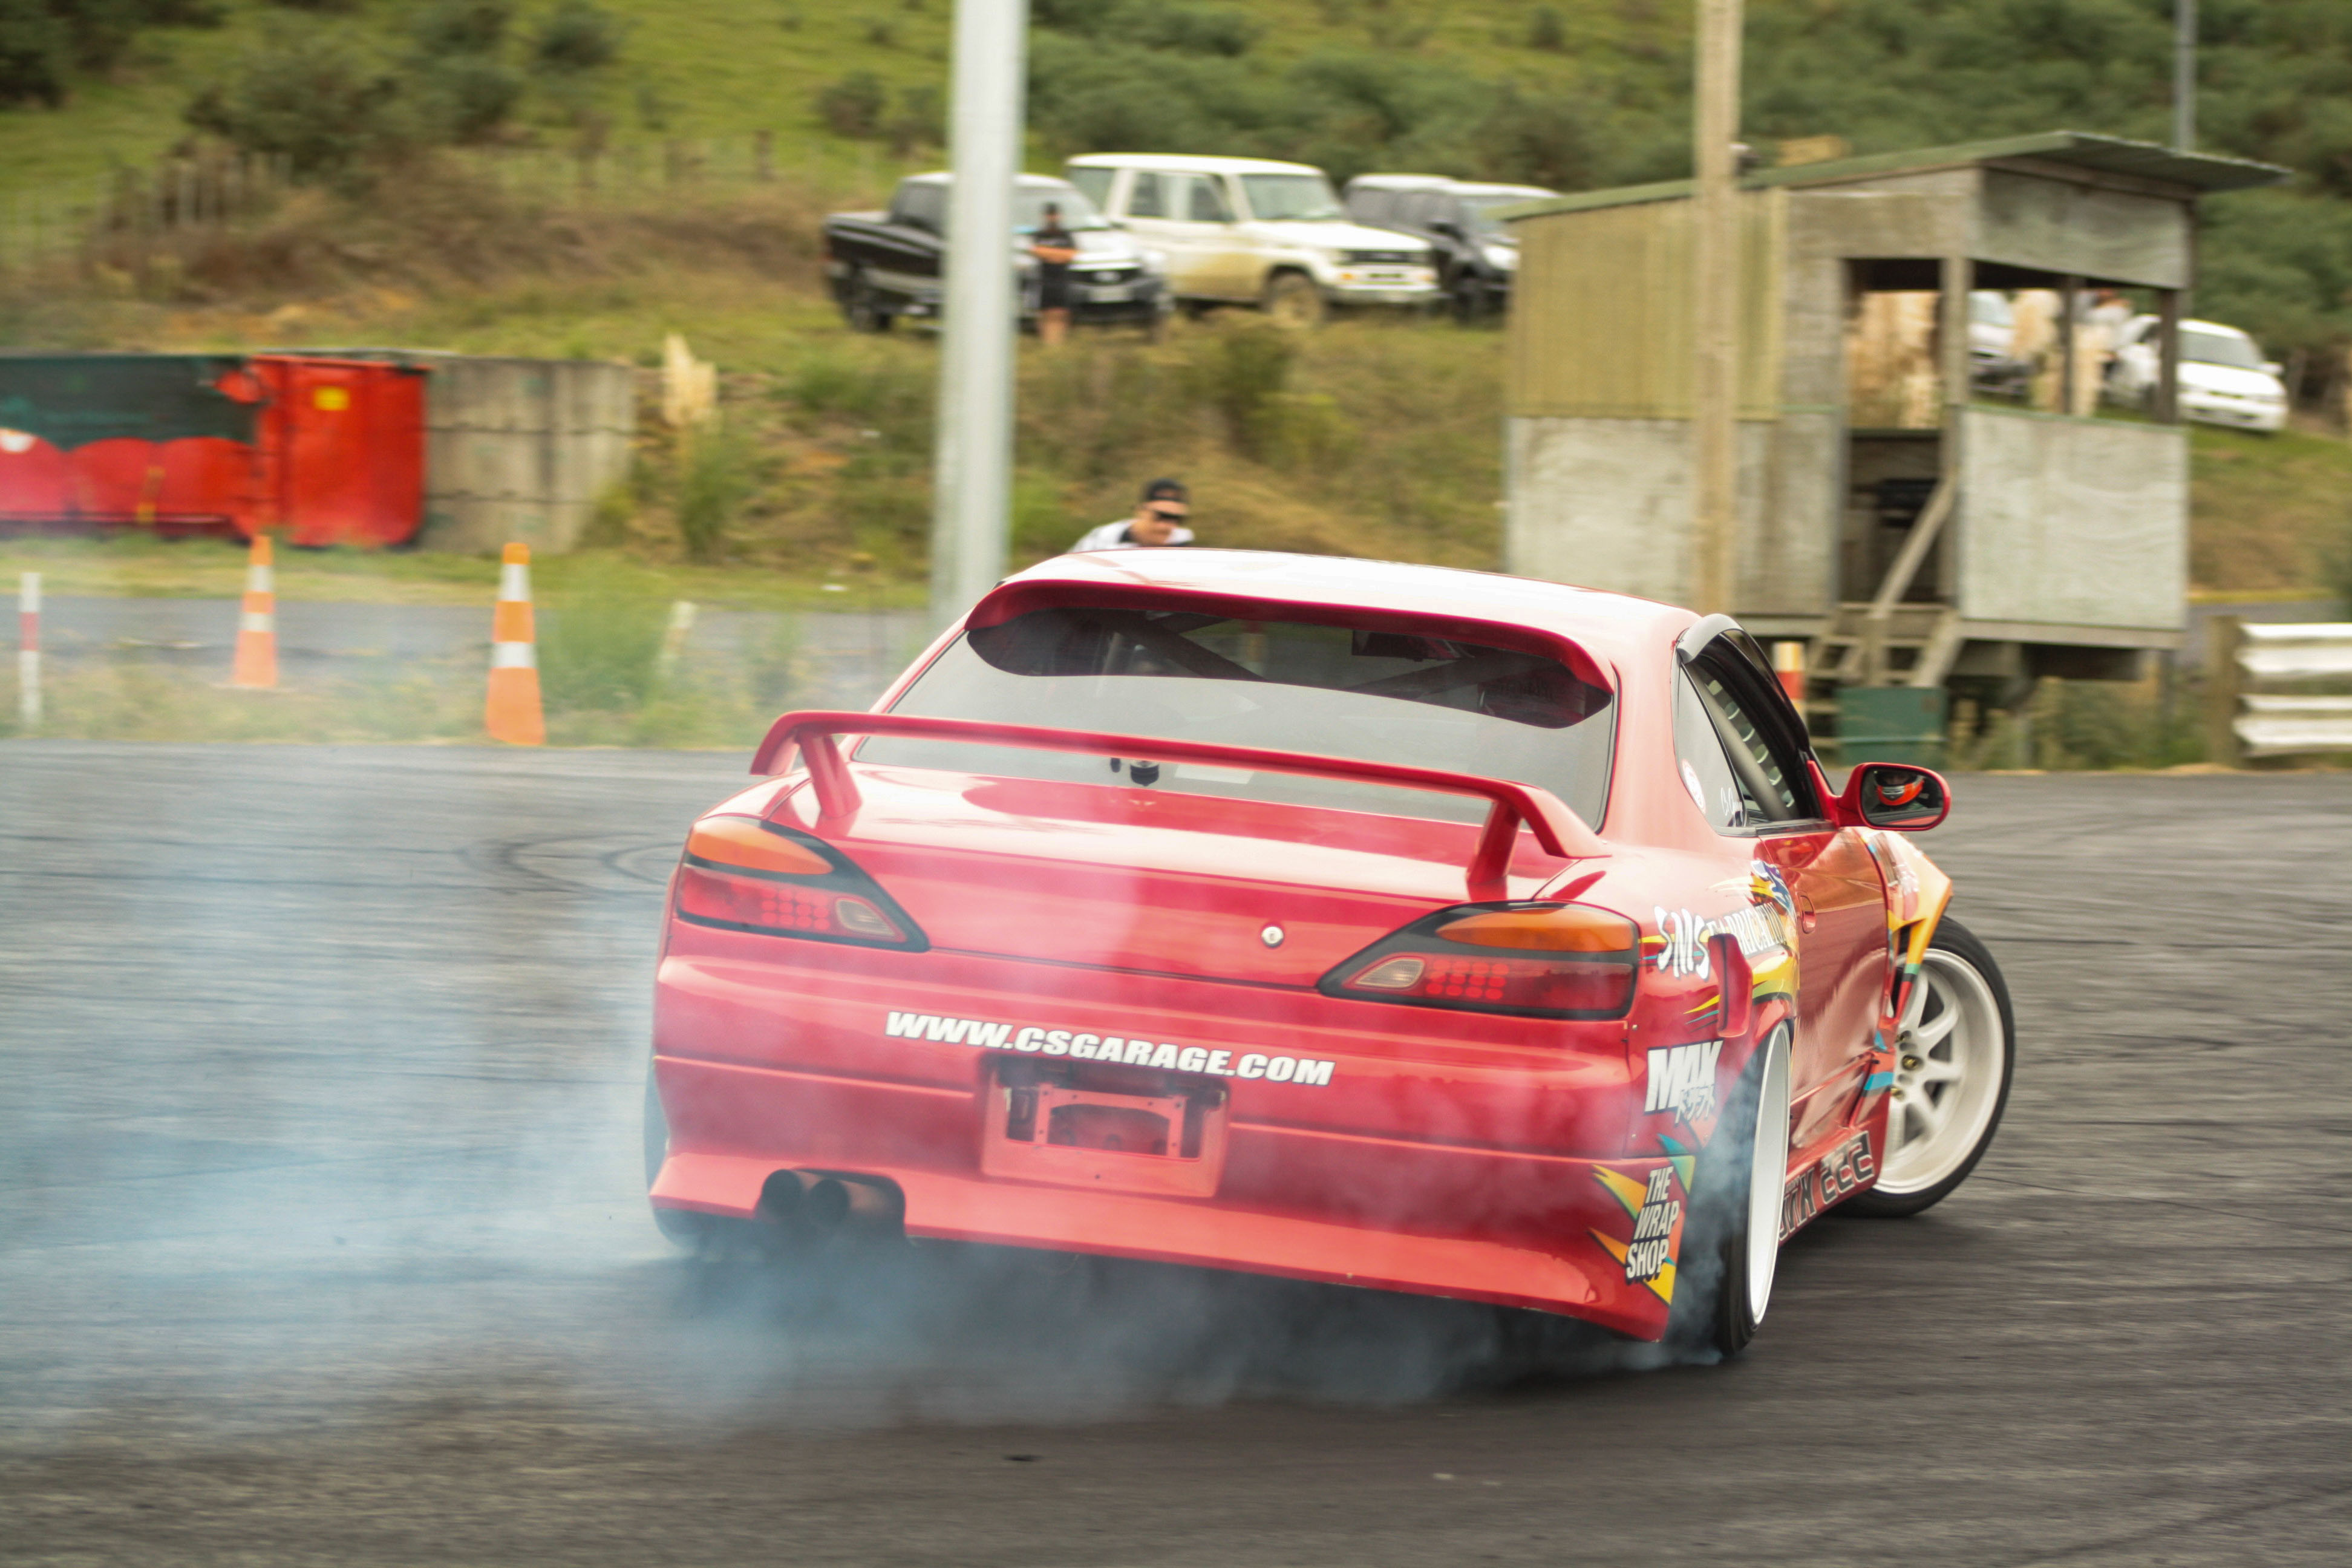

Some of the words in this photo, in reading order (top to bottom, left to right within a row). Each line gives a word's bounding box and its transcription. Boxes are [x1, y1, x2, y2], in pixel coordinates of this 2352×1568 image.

[1654, 906, 1710, 979] SMS
[885, 1010, 1335, 1086] WWW.CSGARAGE.COM
[1644, 1040, 1723, 1112] MAX
[1645, 1166, 1674, 1204] THE
[1633, 1200, 1680, 1240] WRAP
[1626, 1238, 1670, 1279] SHOP
